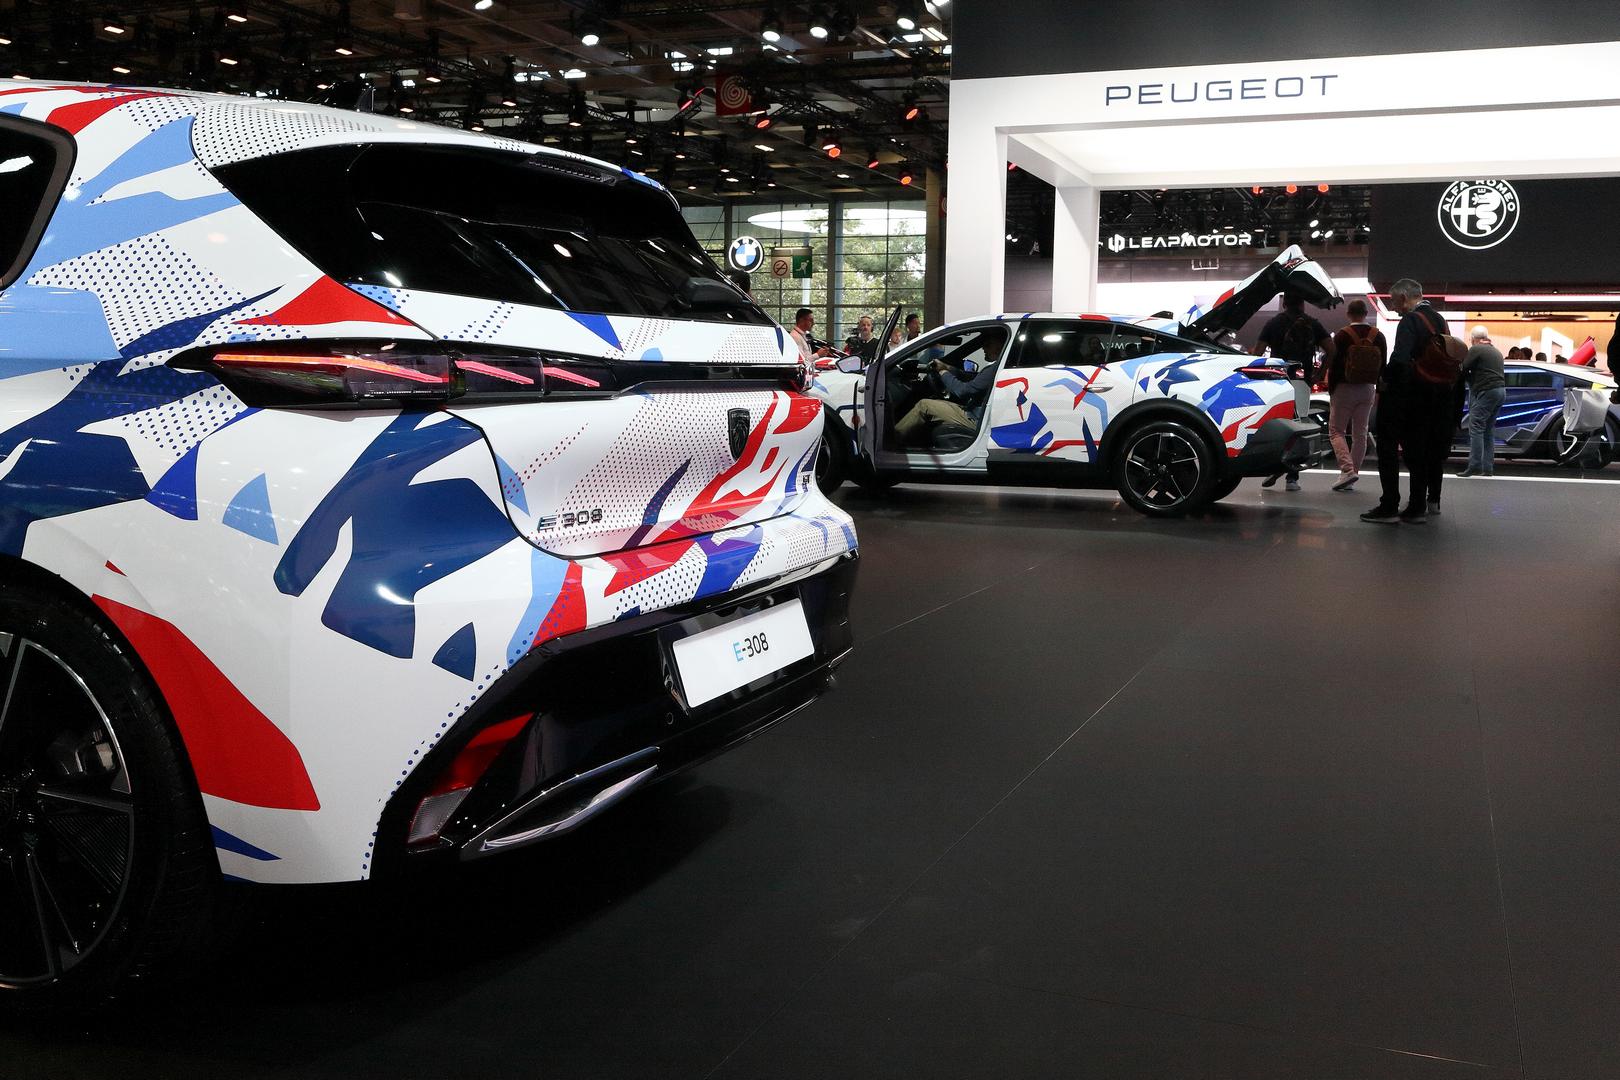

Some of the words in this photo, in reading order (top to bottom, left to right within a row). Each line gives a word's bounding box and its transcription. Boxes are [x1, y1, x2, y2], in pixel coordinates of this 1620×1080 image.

[1105, 75, 1338, 106] PEUGEOT
[1442, 181, 1469, 212] ALFA
[1129, 233, 1252, 249] LEAPMOTOR
[733, 632, 769, 662] E-308
